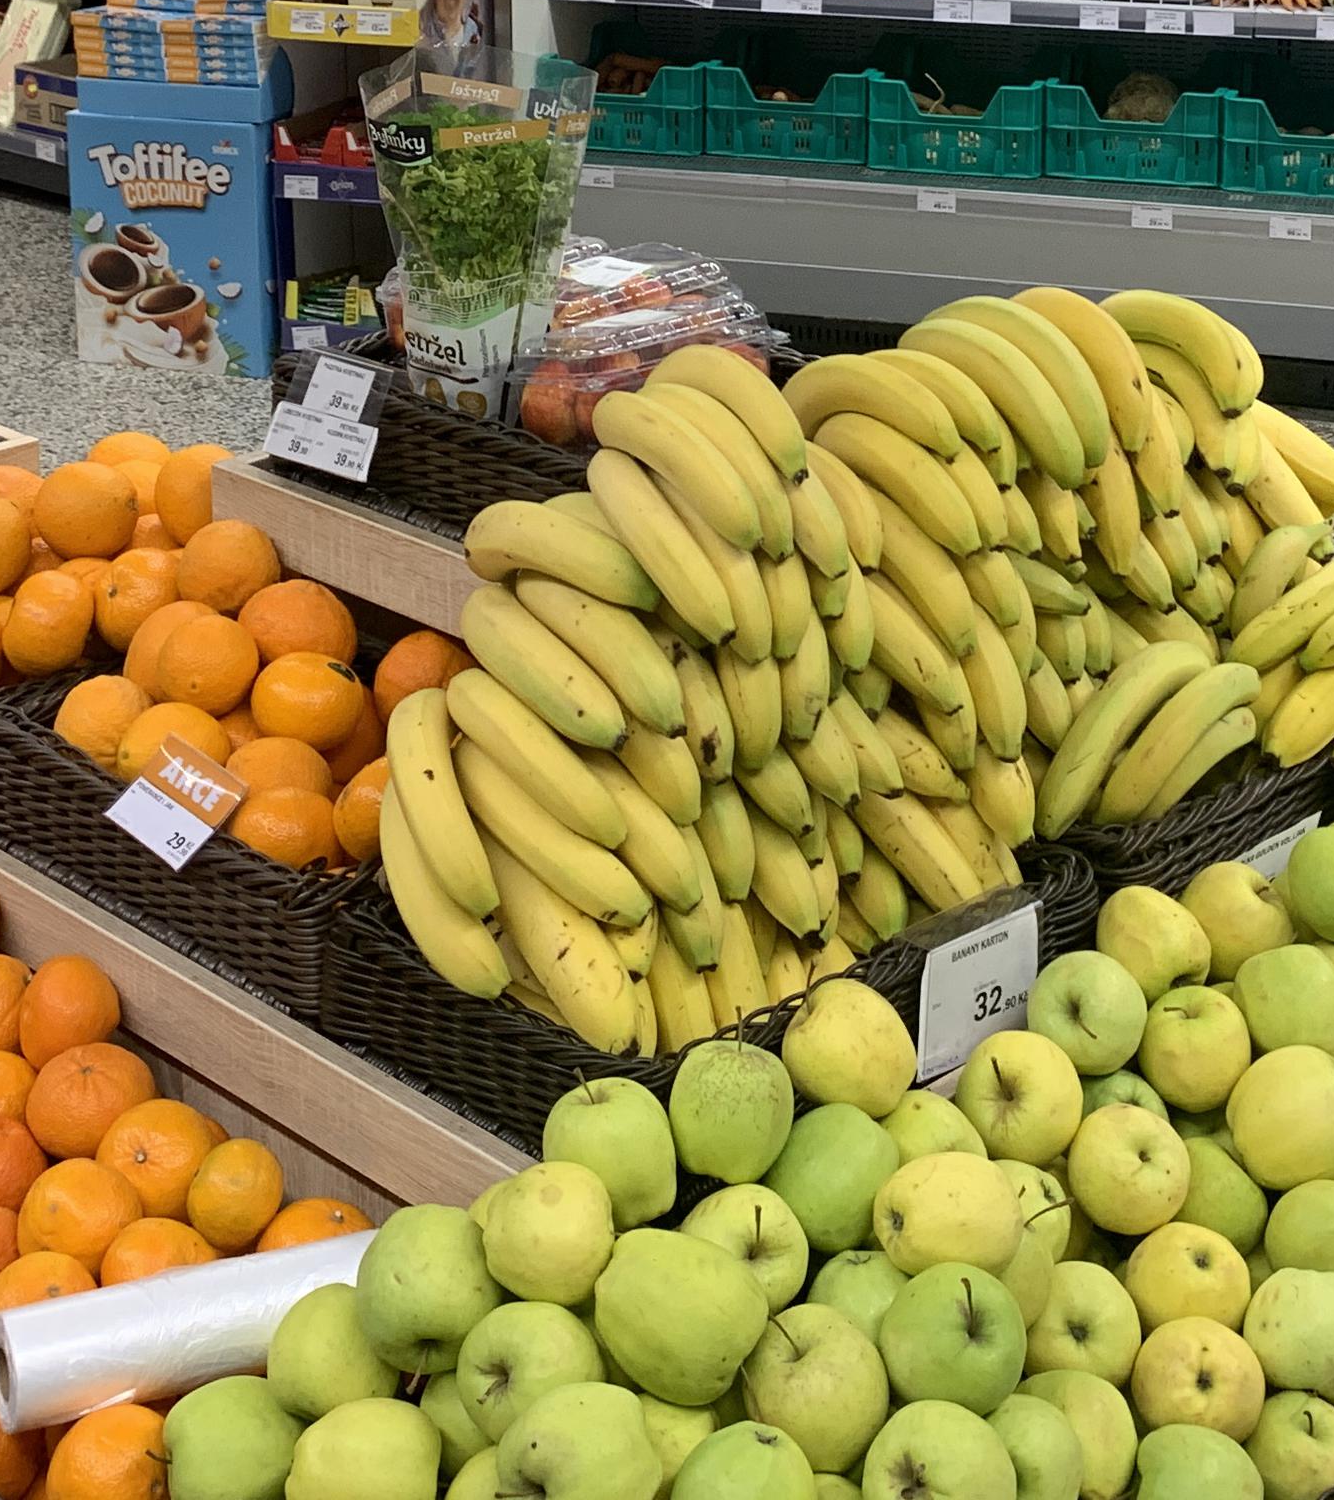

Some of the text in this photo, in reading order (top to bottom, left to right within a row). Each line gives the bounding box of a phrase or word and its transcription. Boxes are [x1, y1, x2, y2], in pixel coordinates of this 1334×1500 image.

[369, 124, 426, 155] Bylinky
[463, 127, 517, 145] Petržel
[87, 140, 233, 195] Toffifee
[123, 182, 206, 204] COCONUT
[330, 180, 355, 191] Orion
[405, 329, 468, 367] etržel
[157, 755, 225, 813] AKCE
[166, 831, 186, 850] 29
